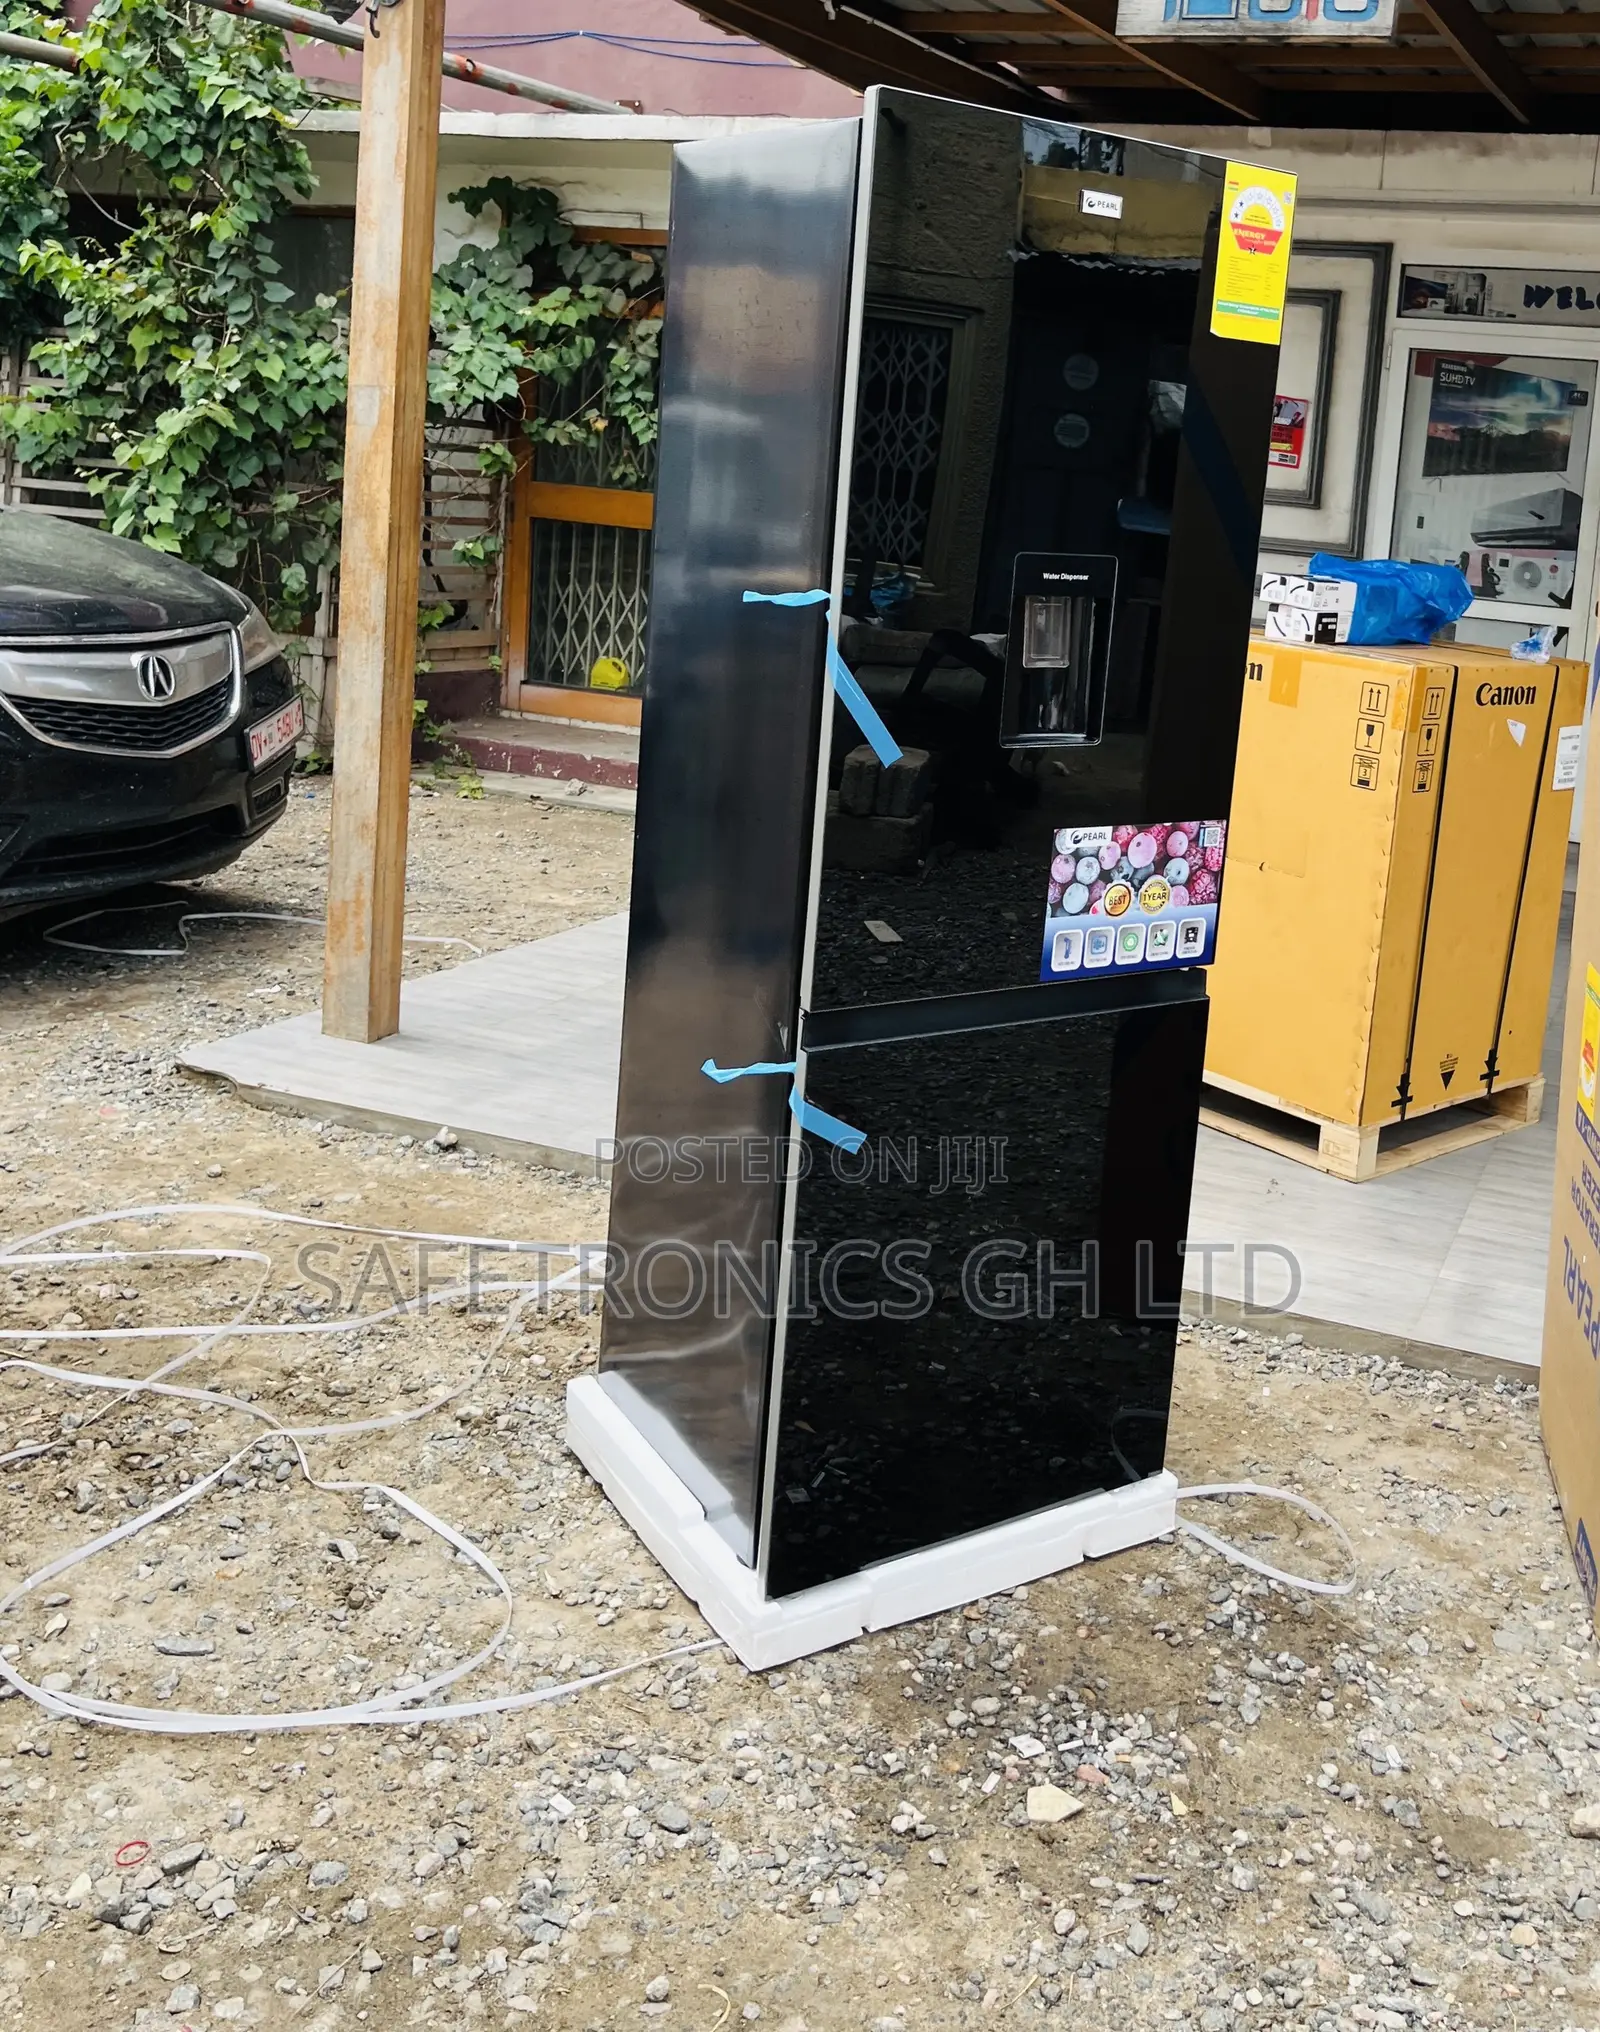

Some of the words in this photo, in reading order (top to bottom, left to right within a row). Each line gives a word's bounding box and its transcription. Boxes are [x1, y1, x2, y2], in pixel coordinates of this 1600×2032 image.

[1096, 200, 1118, 211] PEARL
[1523, 284, 1600, 310] WEL
[1440, 372, 1464, 384] SUHD
[1464, 375, 1476, 386] TV
[1042, 572, 1060, 580] Water
[1060, 573, 1090, 582] Dispenser
[1244, 661, 1264, 682] n
[1475, 682, 1537, 707] Canon
[1083, 831, 1107, 841] PEARL
[1108, 894, 1127, 906] BEST
[1147, 892, 1167, 901] YEAR
[1571, 1175, 1600, 1250] ERATOR
[1563, 1234, 1600, 1361] PEARL
